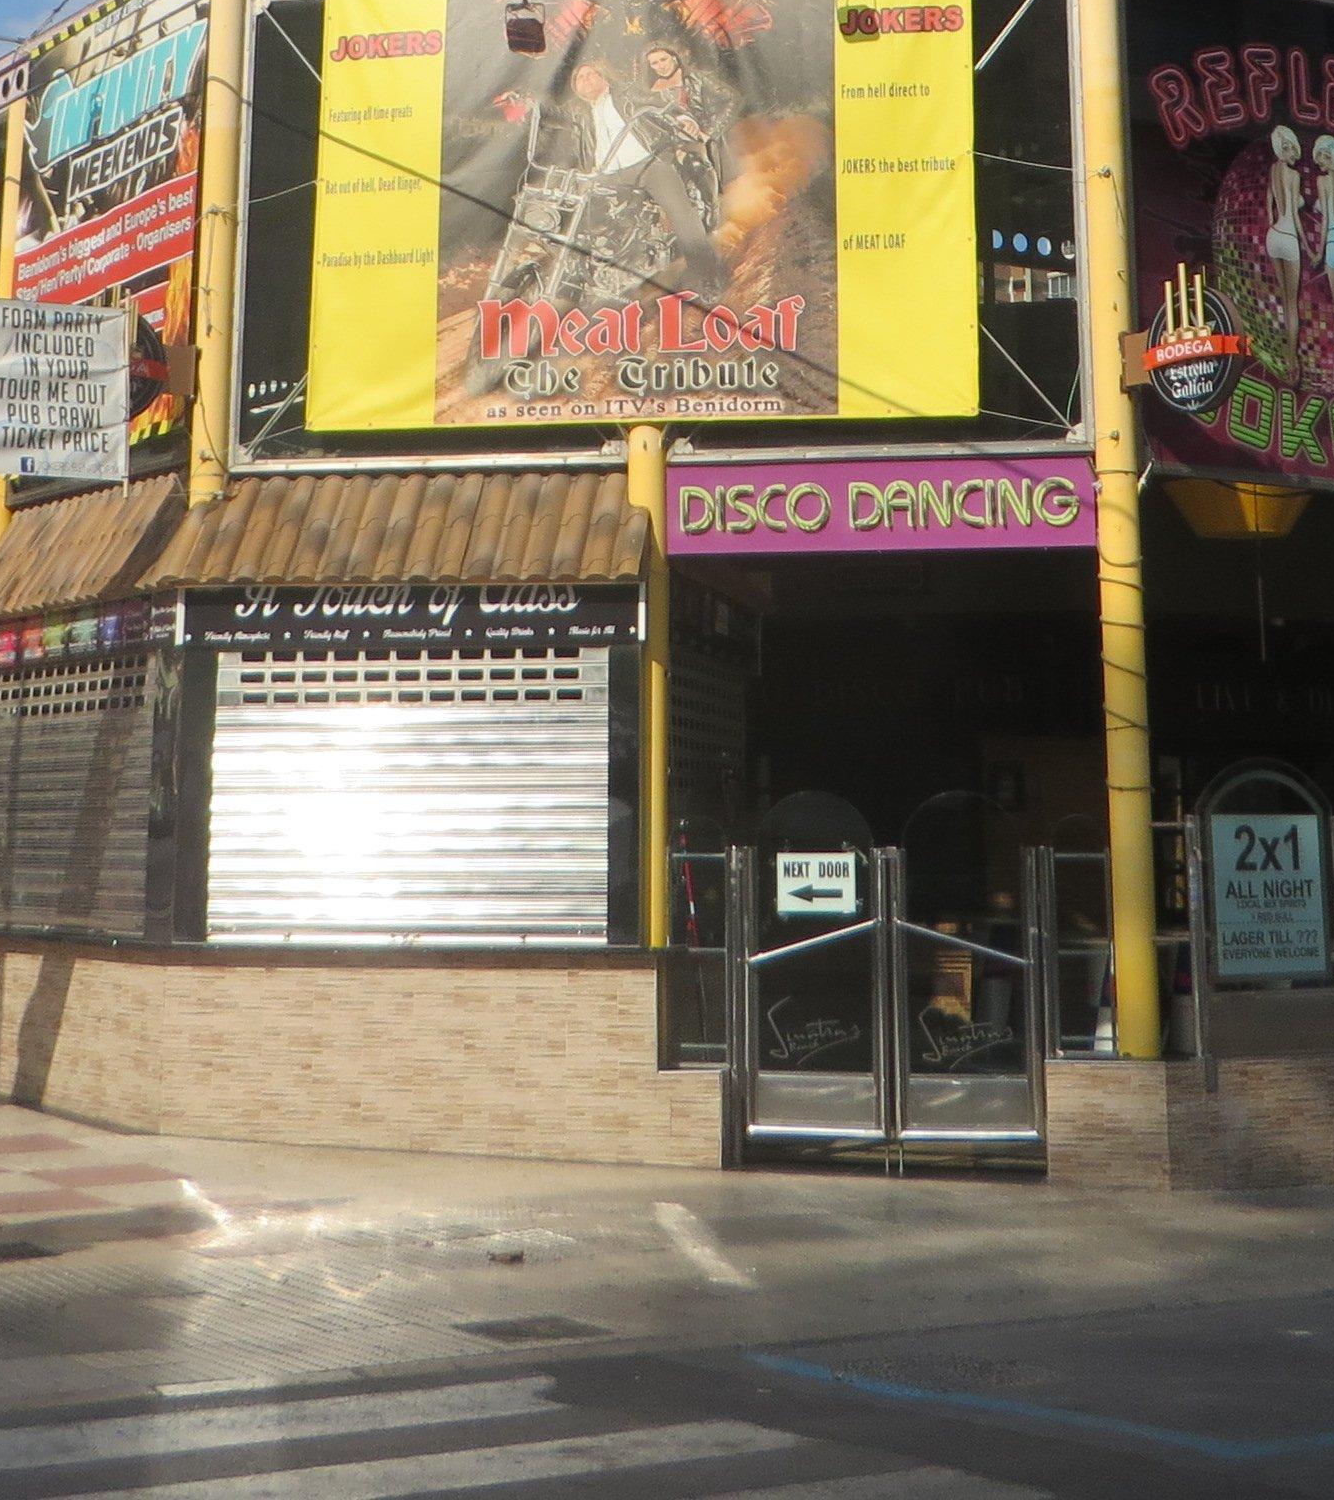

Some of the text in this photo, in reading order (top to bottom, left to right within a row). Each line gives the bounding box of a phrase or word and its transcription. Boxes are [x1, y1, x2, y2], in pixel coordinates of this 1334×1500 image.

[840, 5, 964, 35] JOKERS
[330, 29, 443, 62] JOKERS
[841, 82, 930, 98] From hell direct to
[329, 107, 362, 125] Featuring
[373, 106, 390, 121] time
[391, 105, 413, 123] greats
[69, 112, 182, 198] WEEKENDS
[841, 156, 956, 175] JOKERS the best tribute
[339, 181, 351, 194] out
[352, 179, 360, 194] of
[124, 198, 167, 233] Europe's
[169, 185, 194, 212] best
[137, 216, 193, 251] Organisers
[843, 233, 906, 250] of MEAT LOAF
[322, 252, 353, 268] Paradise
[364, 250, 376, 266] the
[377, 249, 415, 265] Dashboard
[416, 248, 435, 266] Light
[1, 307, 104, 335] FOAM PARTY
[477, 290, 806, 360] Meat Loaf
[14, 331, 94, 358] INCLUDED
[1156, 339, 1214, 362] BODEGA
[24, 357, 89, 381] IN YOUR
[505, 357, 779, 400] The Tribute
[0, 377, 108, 406] TOUR ME OUT
[1171, 377, 1214, 399] Galicia
[7, 403, 104, 429] PUB CRAWL
[487, 398, 783, 419] as seen on ITV's Benidorm
[2, 426, 109, 453] TICKET PRICE
[679, 476, 1082, 534] DISCO DANCING
[293, 585, 413, 617] Touch
[429, 585, 465, 626] of
[1234, 823, 1301, 871] 2x1
[783, 861, 850, 879] NEXT DOOR
[1225, 878, 1315, 900] ALL NIGHT
[1222, 931, 1265, 947] LAGER
[1268, 929, 1294, 944] TILL
[1223, 946, 1320, 961] EVERYONE WELCOME
